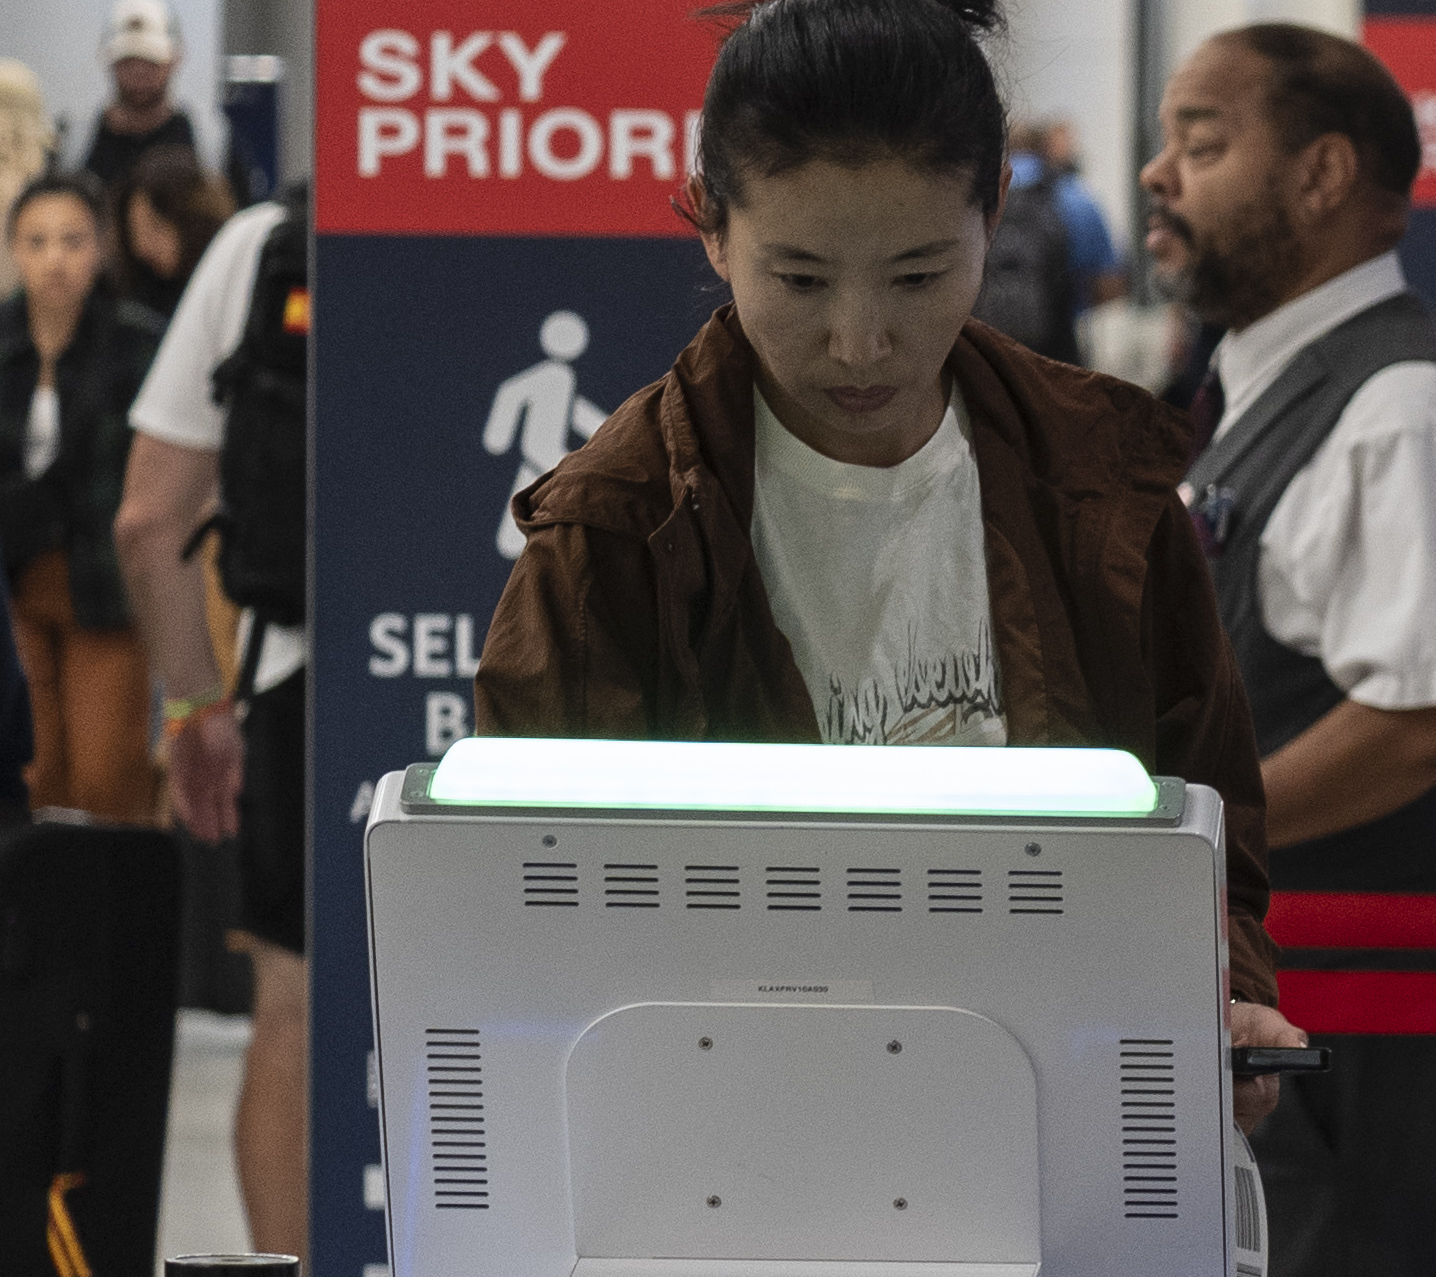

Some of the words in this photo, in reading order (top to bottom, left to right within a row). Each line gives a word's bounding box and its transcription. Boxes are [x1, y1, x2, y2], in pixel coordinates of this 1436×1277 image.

[356, 28, 566, 103] SKY
[357, 106, 704, 181] PRIORI
[368, 612, 481, 679] SEL
